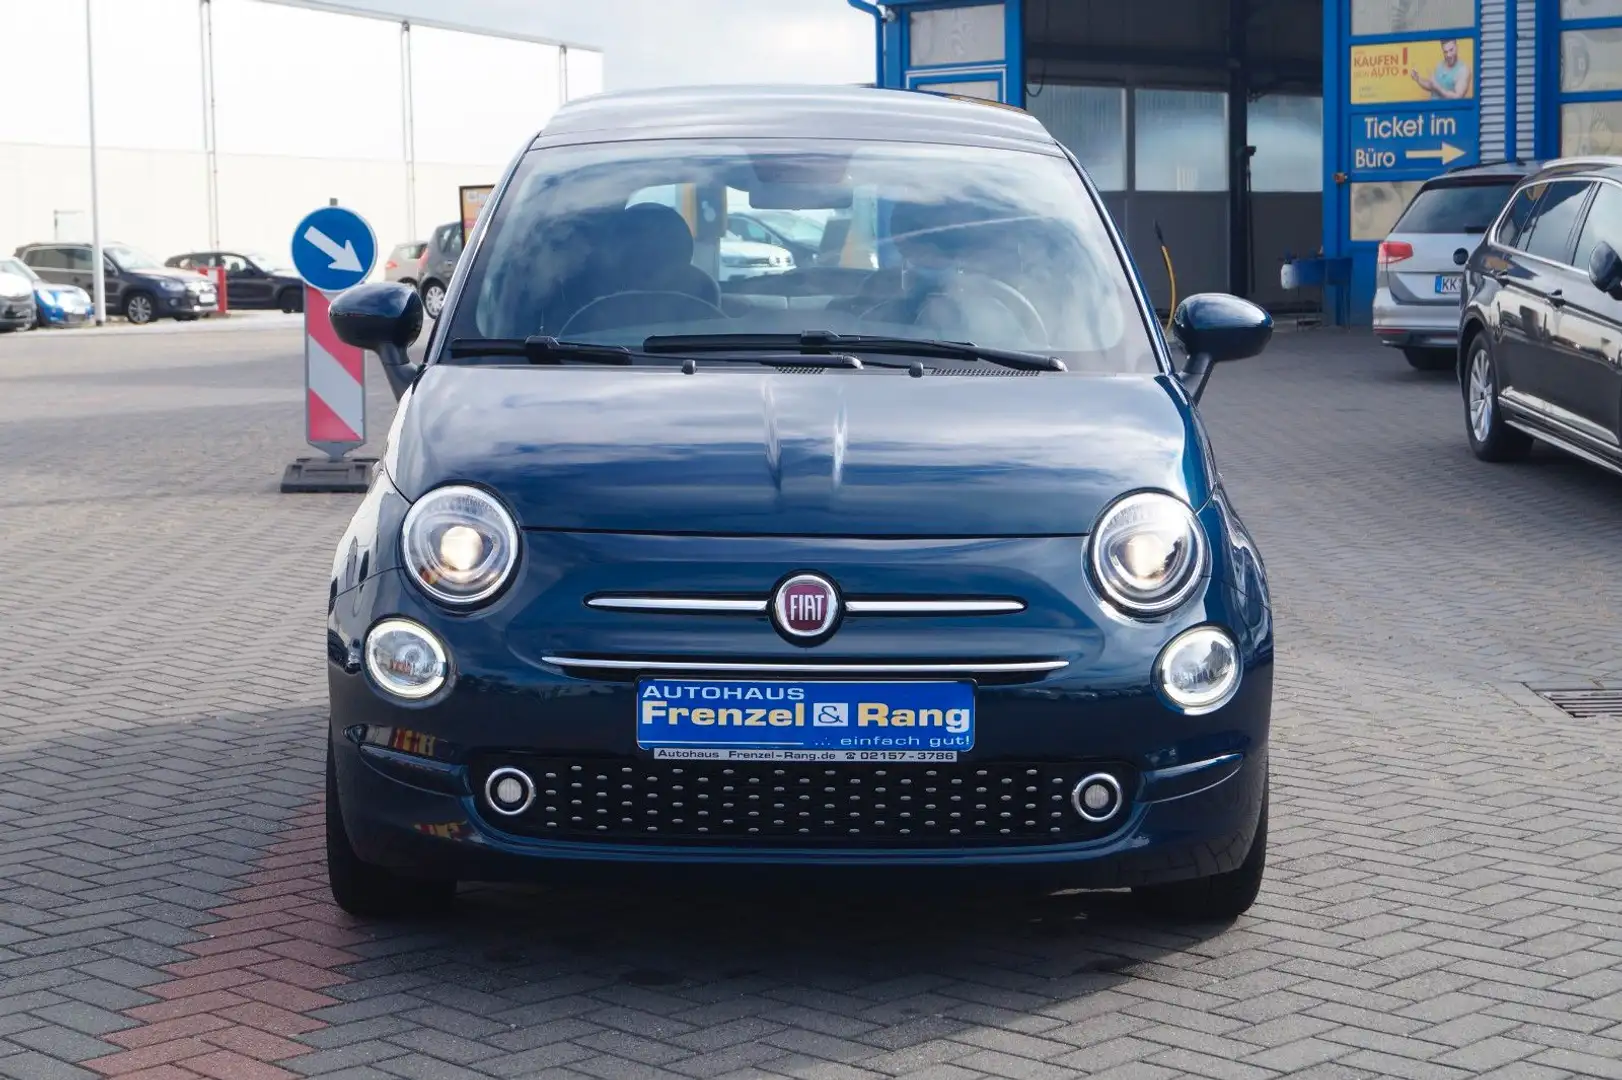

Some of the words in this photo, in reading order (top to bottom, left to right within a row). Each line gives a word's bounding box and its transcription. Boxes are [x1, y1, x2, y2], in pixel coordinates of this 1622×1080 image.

[1354, 54, 1399, 67] KAUFEN
[1370, 66, 1399, 78] AUTO
[1365, 115, 1424, 139] Ticket
[1431, 113, 1456, 136] im
[1355, 148, 1396, 169] Büro
[790, 594, 825, 621] FIAT
[642, 685, 805, 700] AUTOHAUS
[642, 700, 805, 727] Frenzel
[817, 704, 845, 725] &
[857, 702, 970, 733] Rang
[840, 736, 920, 746] einfach
[929, 737, 970, 748] gut!
[657, 749, 720, 759] Autohaus
[728, 750, 836, 761] Frenzel-Rang.de
[860, 752, 954, 761] 02157-3786
